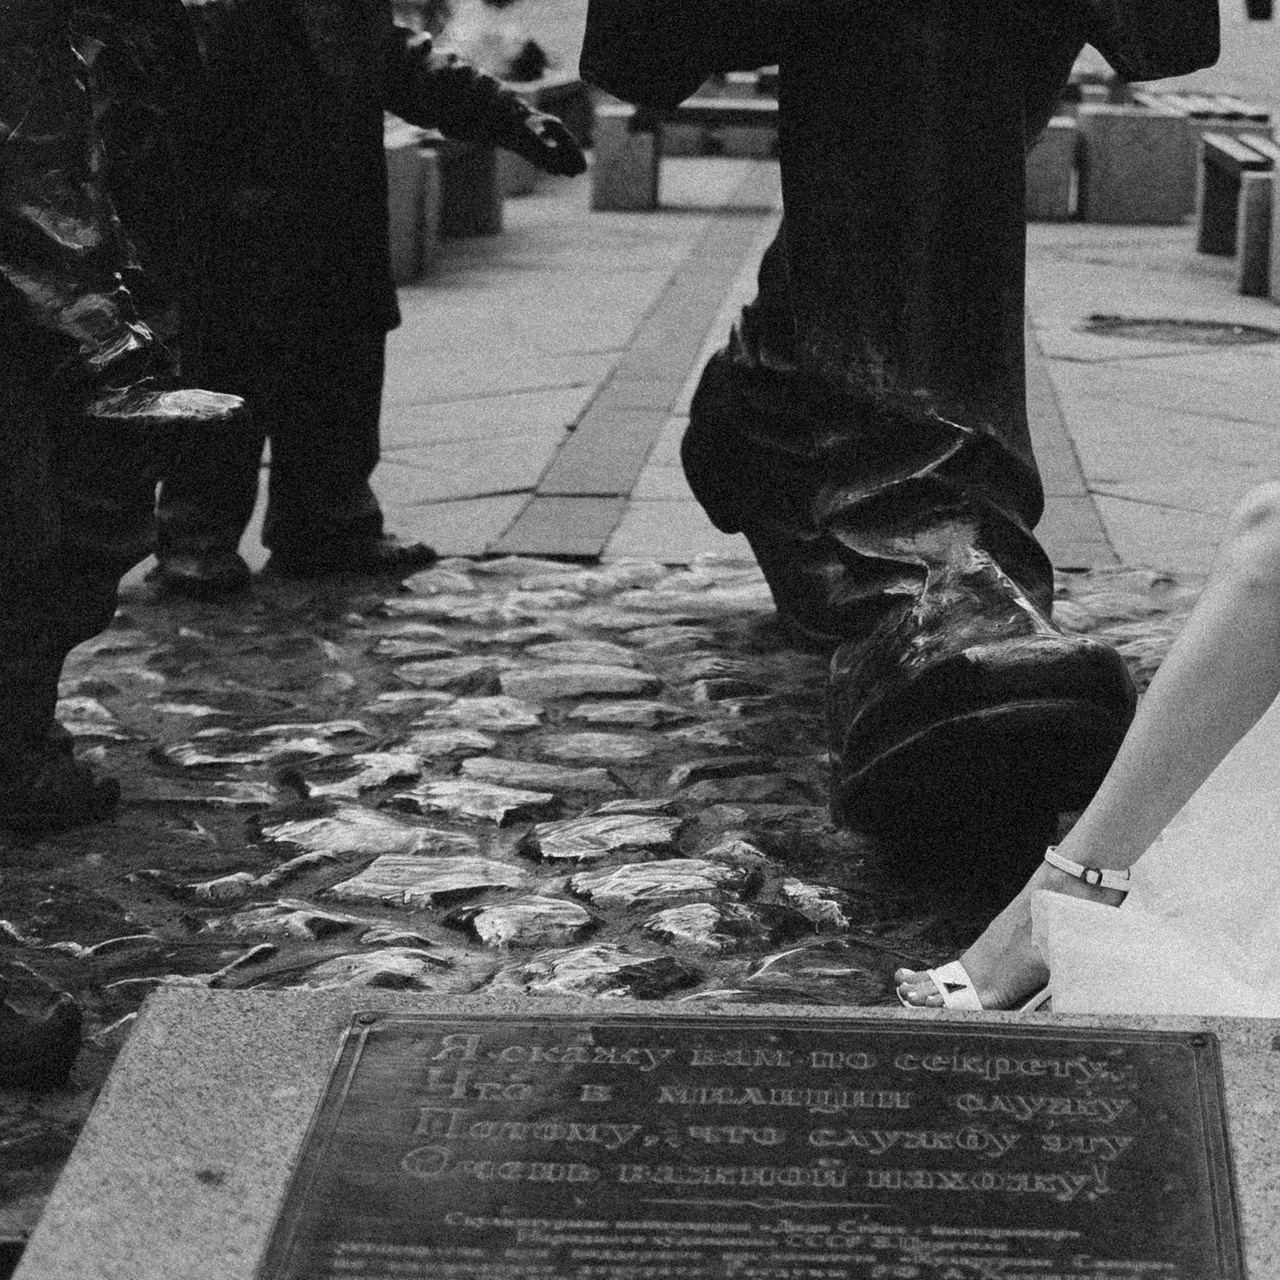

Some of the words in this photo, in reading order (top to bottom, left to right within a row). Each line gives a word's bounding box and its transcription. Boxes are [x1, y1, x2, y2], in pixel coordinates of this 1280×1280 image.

[431, 1033, 482, 1061] Я
[497, 1045, 675, 1072] скажу
[690, 1048, 791, 1068] вам
[809, 1051, 877, 1070] по
[426, 1066, 534, 1102] Что
[580, 1083, 614, 1103] в
[657, 1085, 912, 1115] милиции
[955, 1092, 1135, 1123] служу
[415, 1106, 660, 1151] Потому,
[688, 1124, 788, 1146] что
[807, 1122, 1022, 1159] службу
[1040, 1134, 1136, 1161] эту
[401, 1144, 601, 1183] Очень
[618, 1157, 847, 1188] важной
[865, 1163, 1111, 1202] нахожу!
